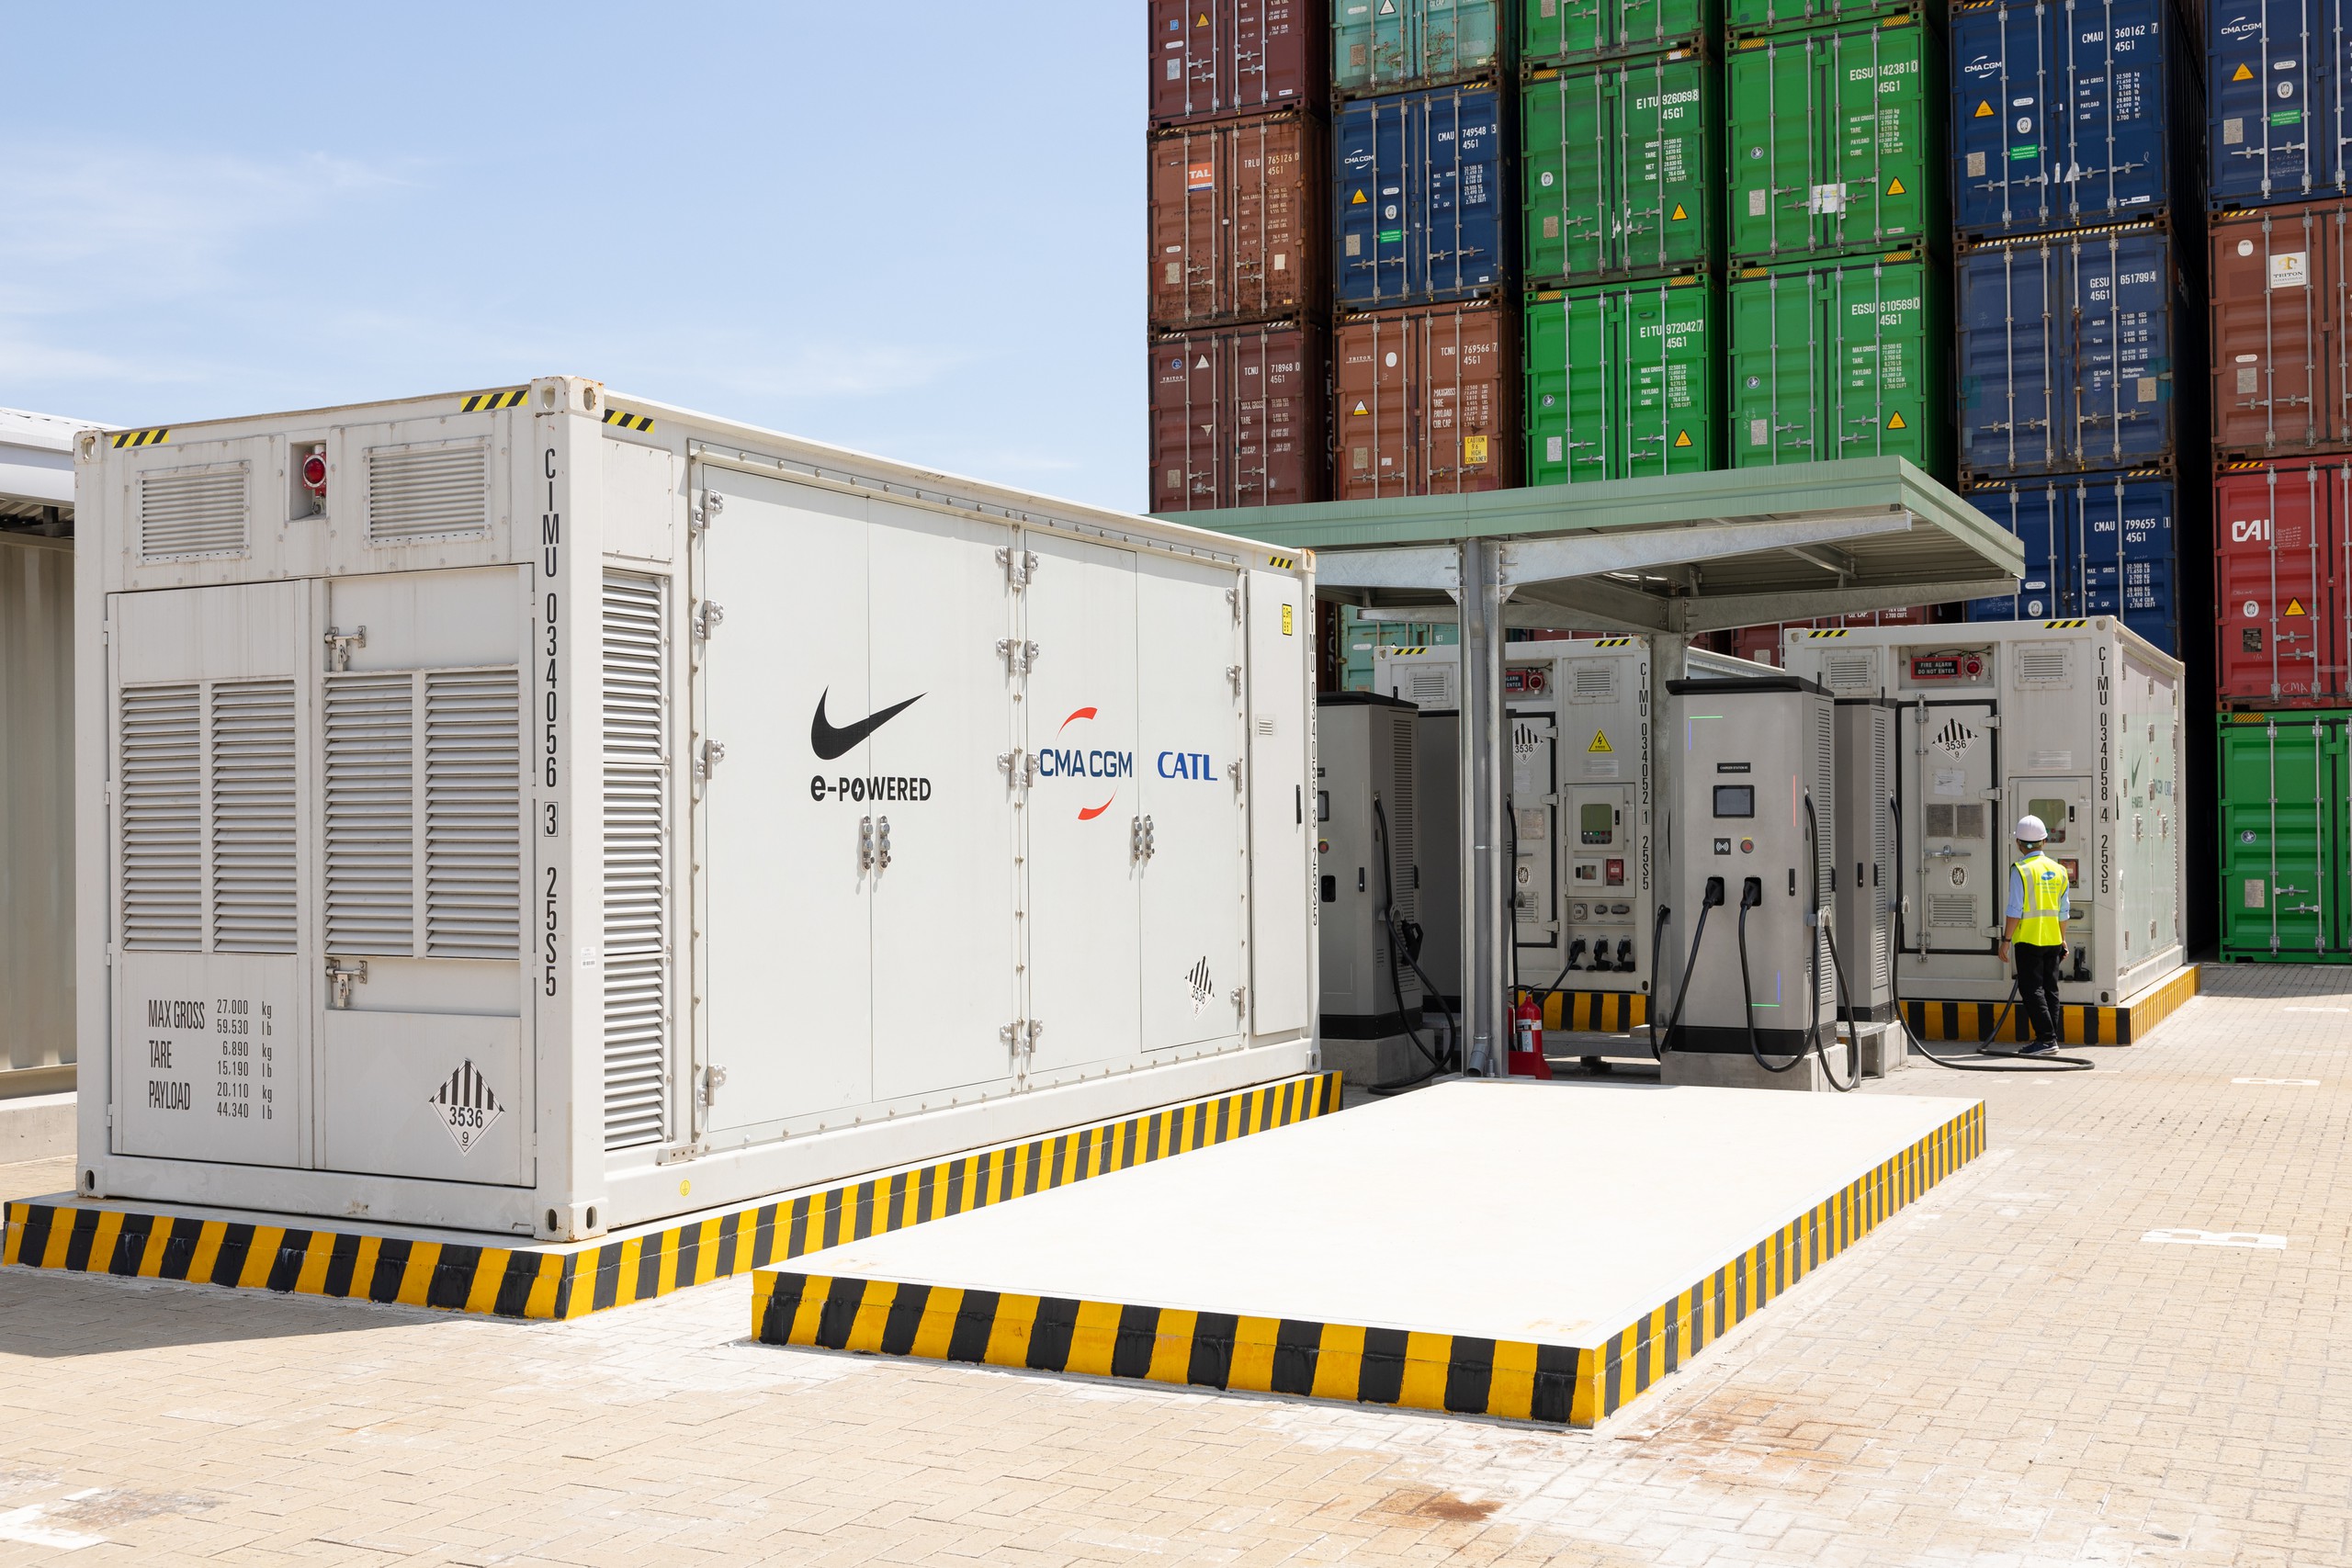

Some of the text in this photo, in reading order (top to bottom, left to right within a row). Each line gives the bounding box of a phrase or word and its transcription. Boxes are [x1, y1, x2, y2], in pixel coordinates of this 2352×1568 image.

[2082, 23, 2158, 43] CMAU 360162 7
[2221, 23, 2262, 34] CMA CGM
[2115, 41, 2135, 52] 45G1
[1965, 61, 2002, 73] CMA CGM
[1850, 67, 1874, 81] EGSU
[1878, 81, 1900, 93] 45G1
[1636, 96, 1659, 110] EITU
[1662, 107, 1683, 120] 45G1
[1438, 125, 1497, 142] CMAU 749548 3
[1463, 139, 1478, 149] 45G1
[1244, 152, 1299, 168] TRLU 765126 0
[1189, 169, 1211, 179] TAL
[1268, 166, 1283, 176] 45G1
[2090, 277, 2109, 289] GESU
[2090, 290, 2110, 301] 45G1
[1852, 302, 1875, 316] EGSU
[1880, 314, 1902, 326] 45G1
[1640, 326, 1662, 338] EITU
[1441, 342, 1498, 356] TCNU 769566 7
[1667, 336, 1687, 349] 45G1
[1464, 356, 1481, 365] 45G1
[1245, 362, 1300, 375] TCNU 718968 0
[1271, 375, 1285, 383] 45G1
[1433, 399, 1444, 407] TARE
[1434, 409, 1452, 417] PAYLOAD
[1241, 416, 1251, 425] TARE
[2094, 517, 2171, 532] CMAU 799655 1
[2232, 519, 2269, 542] CAI
[2126, 532, 2146, 542] 45G1
[2282, 683, 2308, 694] CMA
[542, 448, 560, 998] CIMU 034056 3 25S5
[1515, 744, 1533, 754] 3536
[1945, 740, 1967, 751] 3536
[1040, 748, 1133, 779] CMA CGM
[1157, 750, 1218, 782] CATL
[1638, 662, 1650, 890] CIMU 034052 1 25S5
[2098, 646, 2110, 895] CIMU 034058 4 25S5
[1192, 985, 1206, 1004] 3536
[149, 1000, 171, 1028] MAX
[175, 1000, 205, 1029] GROSS
[262, 1001, 271, 1019] kg
[149, 1040, 172, 1068] TARE
[262, 1043, 272, 1061] kg
[149, 1080, 190, 1110] PAYLOAD
[263, 1085, 272, 1102] kg
[449, 1107, 483, 1128] 3536
[462, 1131, 469, 1146] 9
